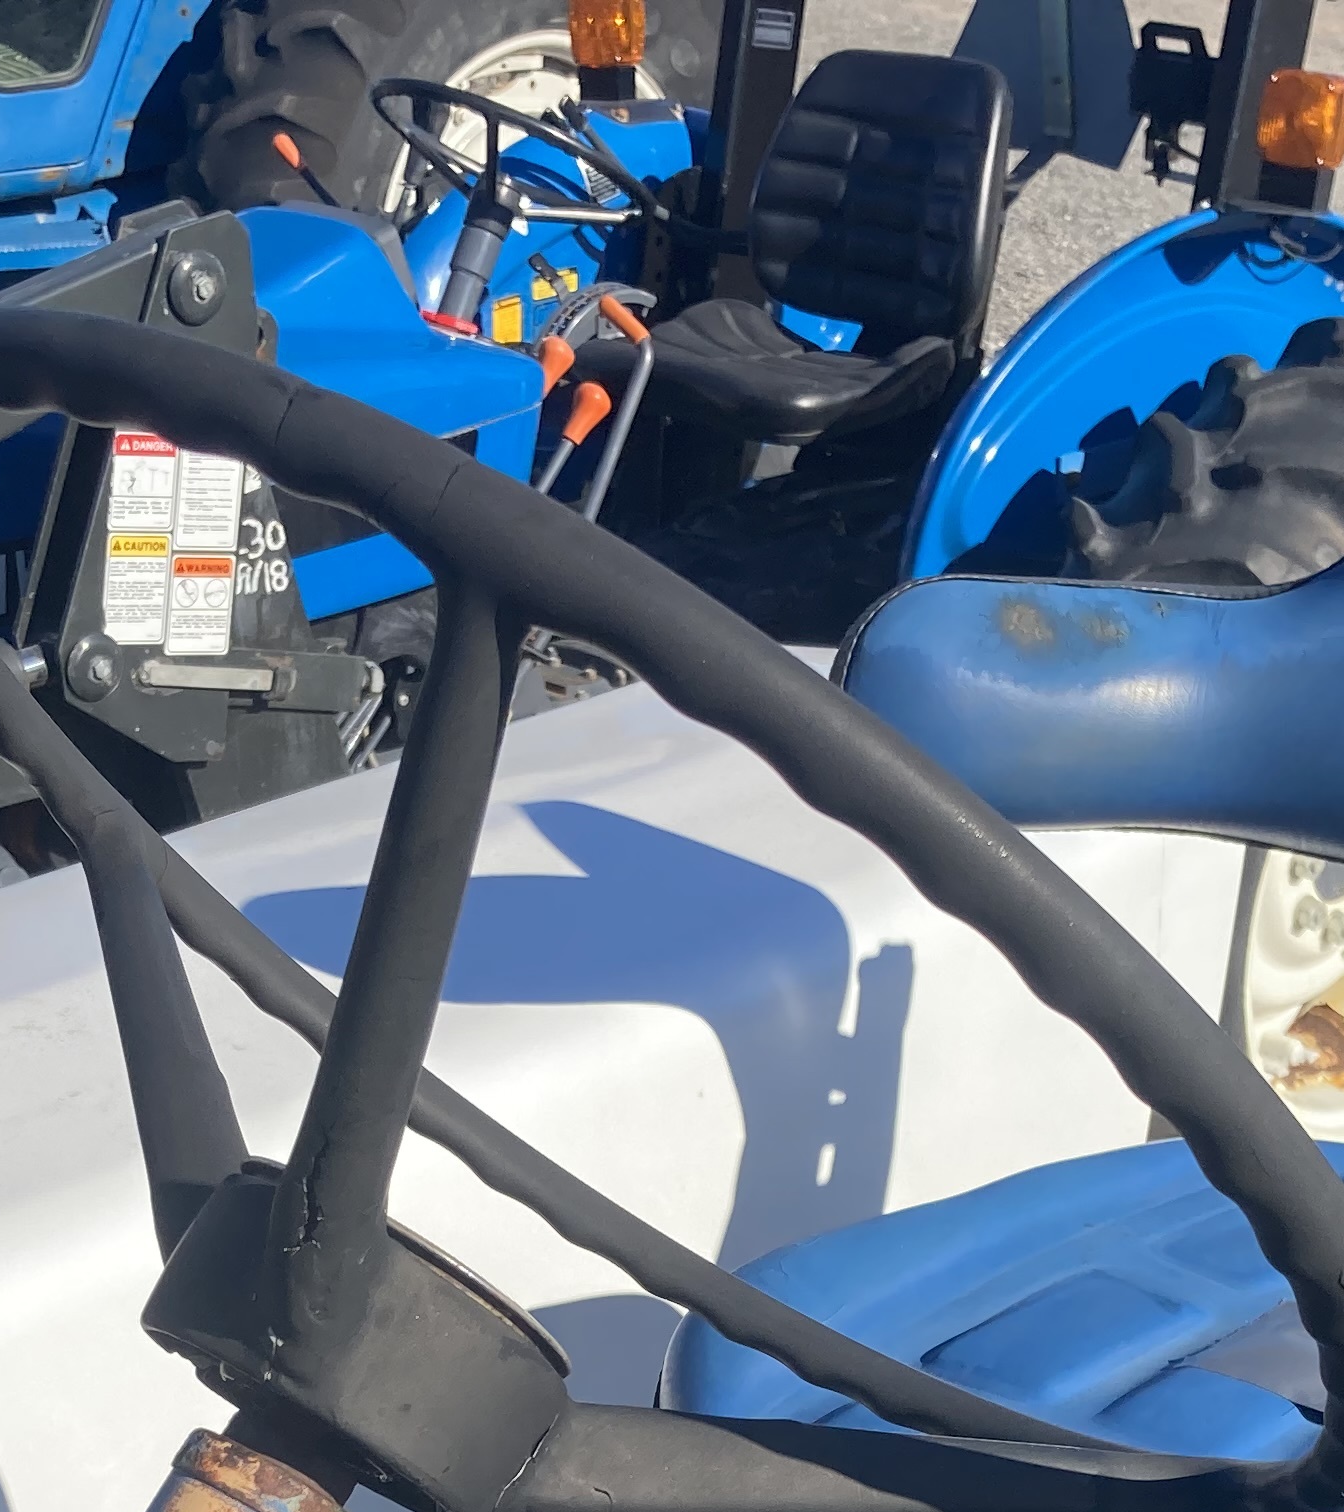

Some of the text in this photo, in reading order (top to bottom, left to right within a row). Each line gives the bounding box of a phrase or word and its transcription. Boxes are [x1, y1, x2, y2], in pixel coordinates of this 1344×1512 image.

[132, 441, 173, 452] DANGER
[123, 541, 166, 552] CAUTION
[186, 563, 230, 574] WARNING
